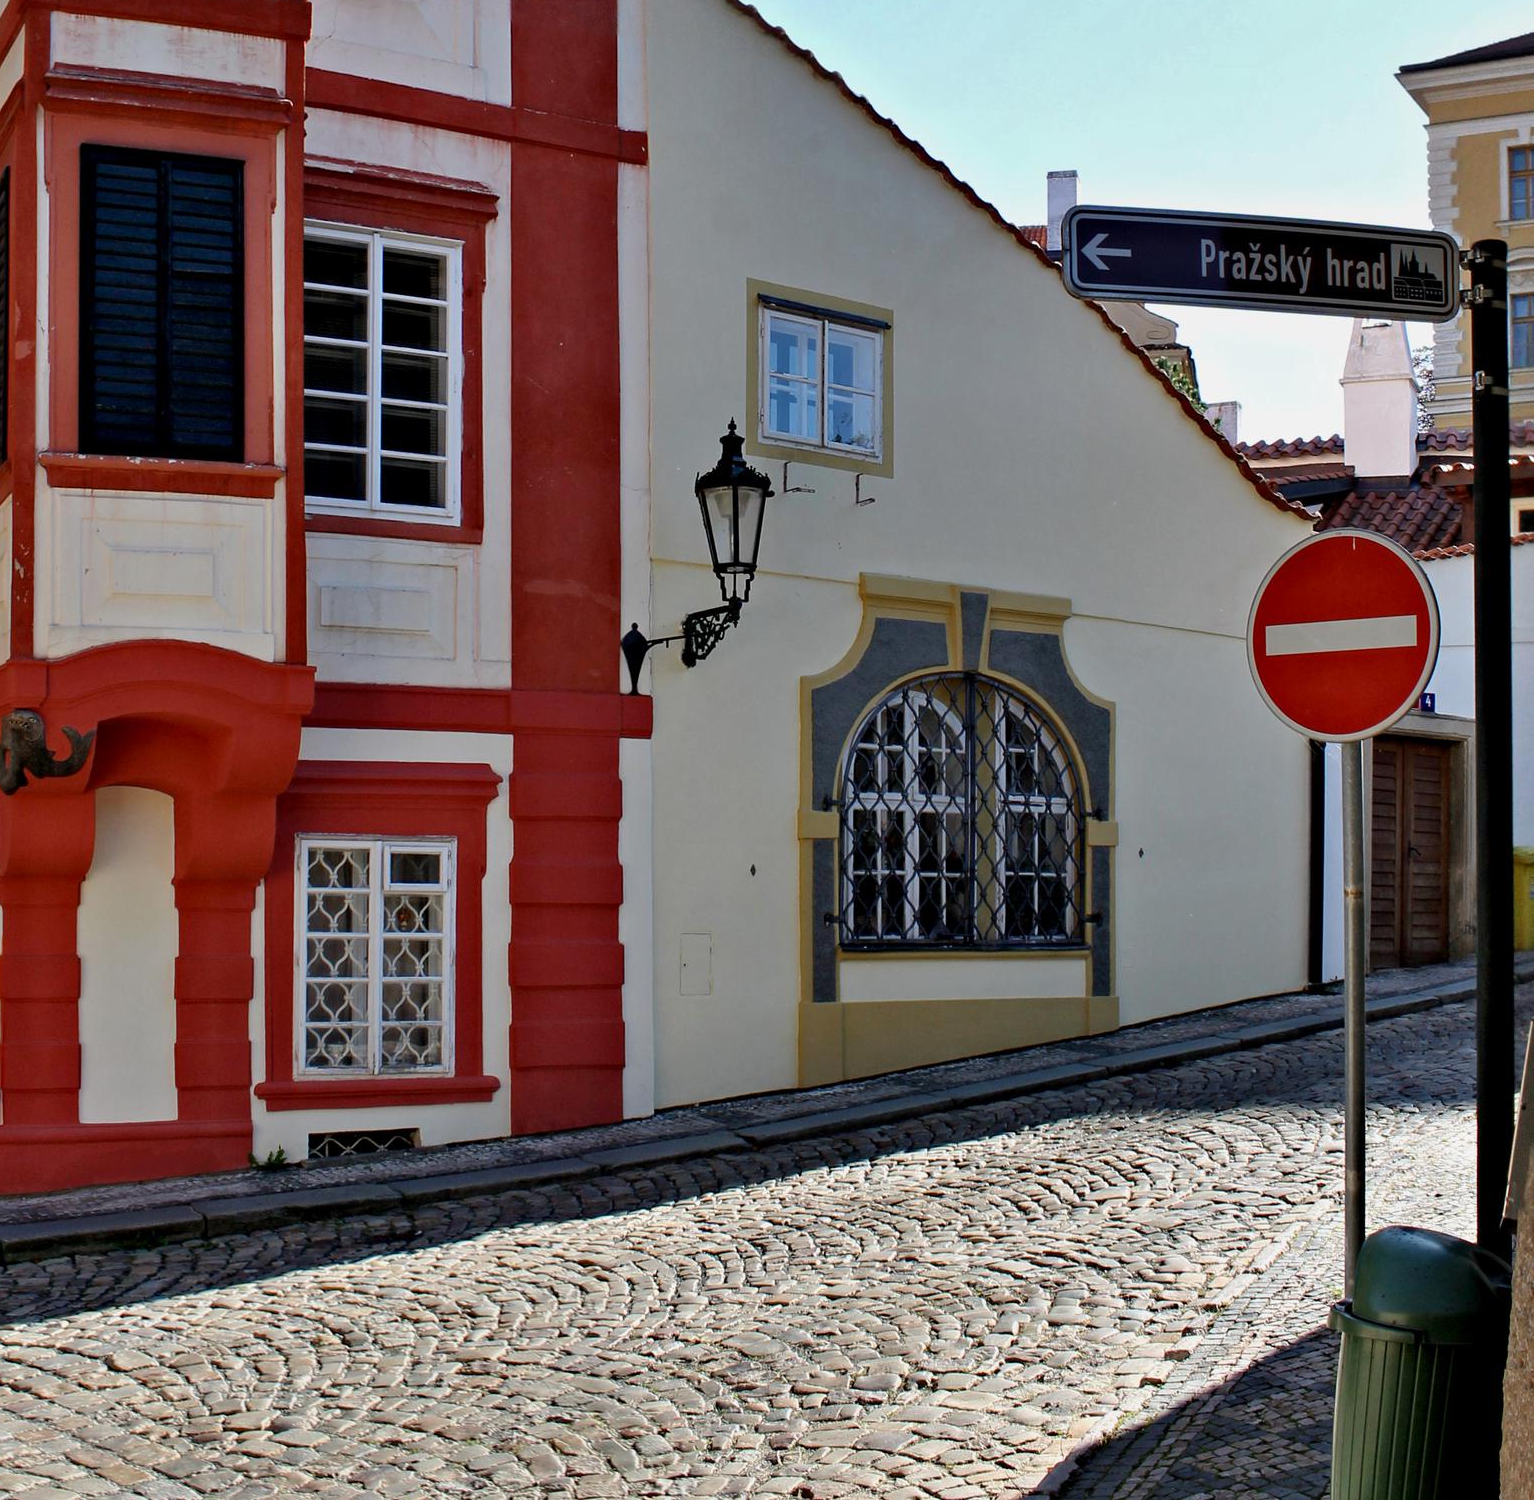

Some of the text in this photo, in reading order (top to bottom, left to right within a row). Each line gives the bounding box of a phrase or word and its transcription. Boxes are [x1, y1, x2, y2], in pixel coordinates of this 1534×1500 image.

[1200, 238, 1386, 294] Pražský hrad
[1425, 694, 1432, 708] 4
